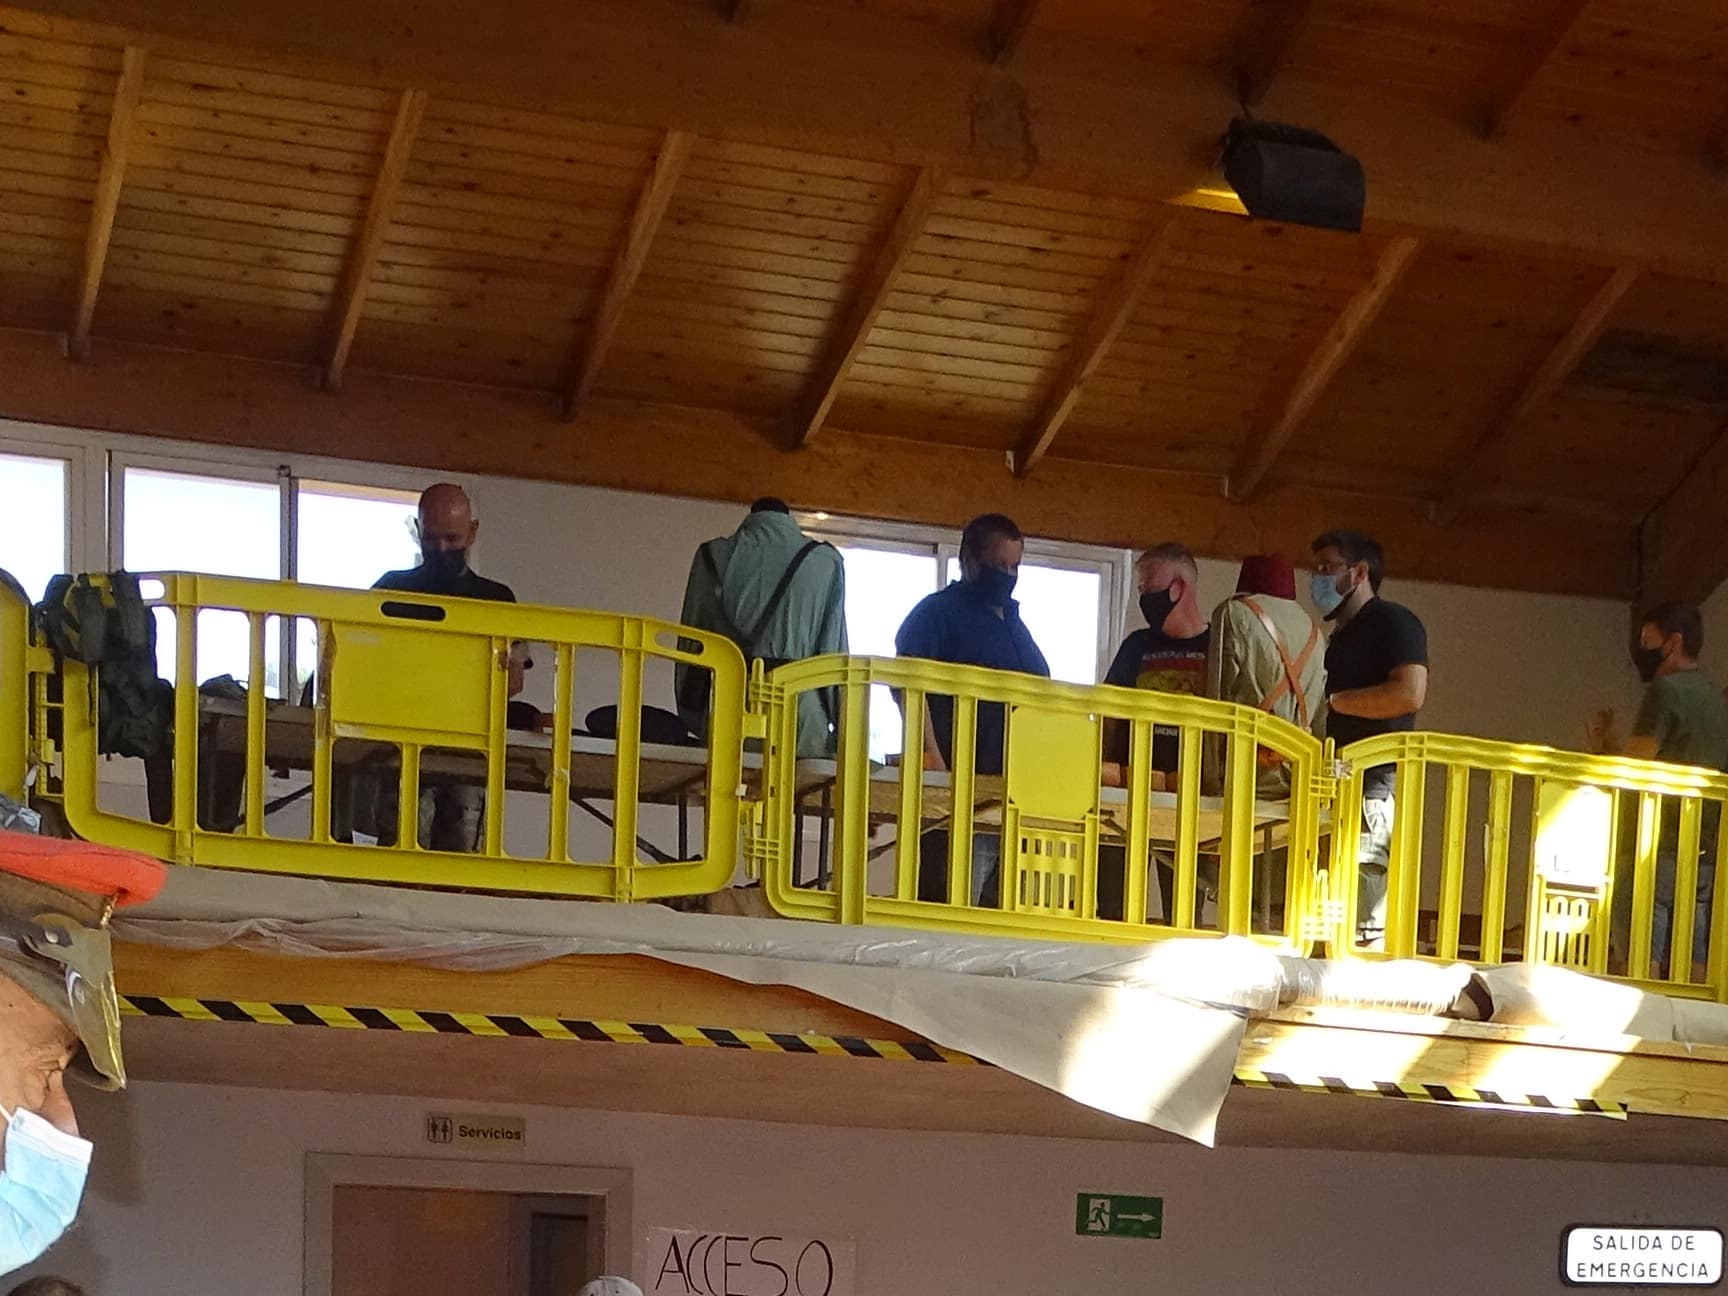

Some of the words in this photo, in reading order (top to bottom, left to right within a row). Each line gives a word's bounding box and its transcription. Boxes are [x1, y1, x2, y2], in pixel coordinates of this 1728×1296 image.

[458, 1124, 522, 1141] Servicios
[1592, 1234, 1663, 1251] SALIDA
[1671, 1234, 1696, 1251] DE
[1576, 1261, 1710, 1278] EMERGENCIA
